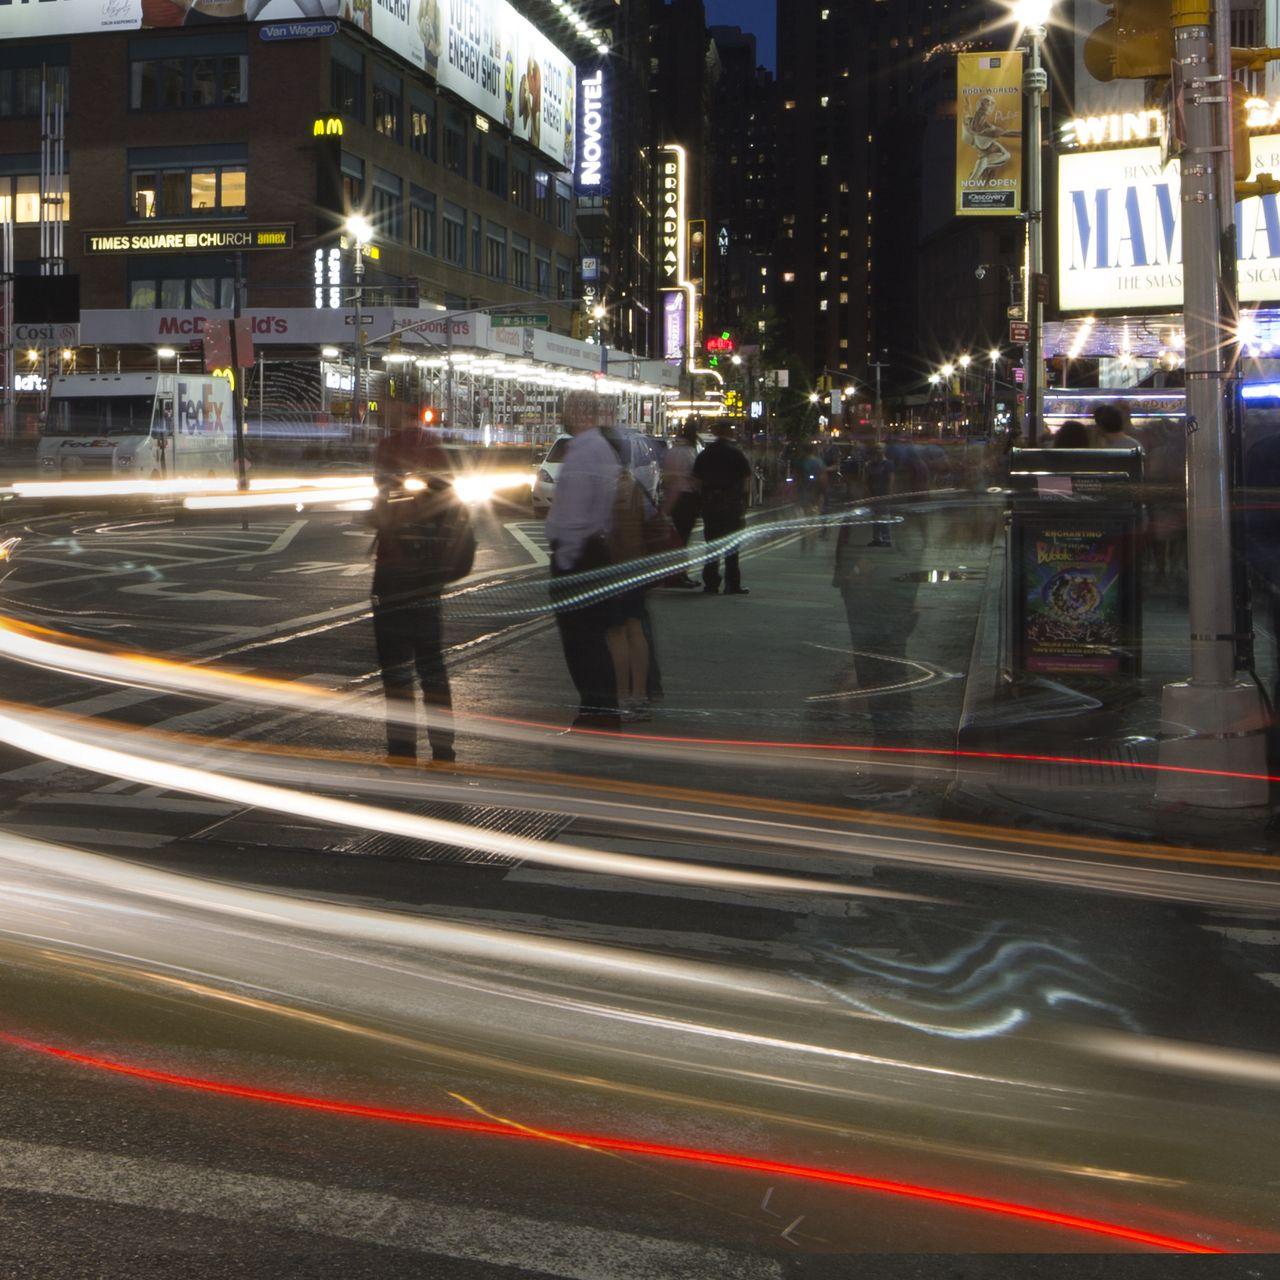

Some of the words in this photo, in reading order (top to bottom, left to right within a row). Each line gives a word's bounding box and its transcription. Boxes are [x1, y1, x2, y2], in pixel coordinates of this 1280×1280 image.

[266, 26, 287, 37] Van
[289, 23, 333, 38] Wagner
[448, 28, 481, 85] ENERGY
[482, 59, 502, 100] SHOT
[581, 69, 603, 185] NOVOTEL
[961, 179, 988, 187] NOW
[988, 178, 1017, 187] OPEN
[663, 163, 677, 277] BROADWAY
[91, 236, 130, 250] TIMES
[131, 234, 184, 249] SQUARE
[198, 232, 252, 247] CHURCH
[257, 232, 286, 245] annex
[1146, 273, 1183, 289] SMAS
[158, 316, 288, 335] McDld's
[177, 382, 225, 436] FedEx
